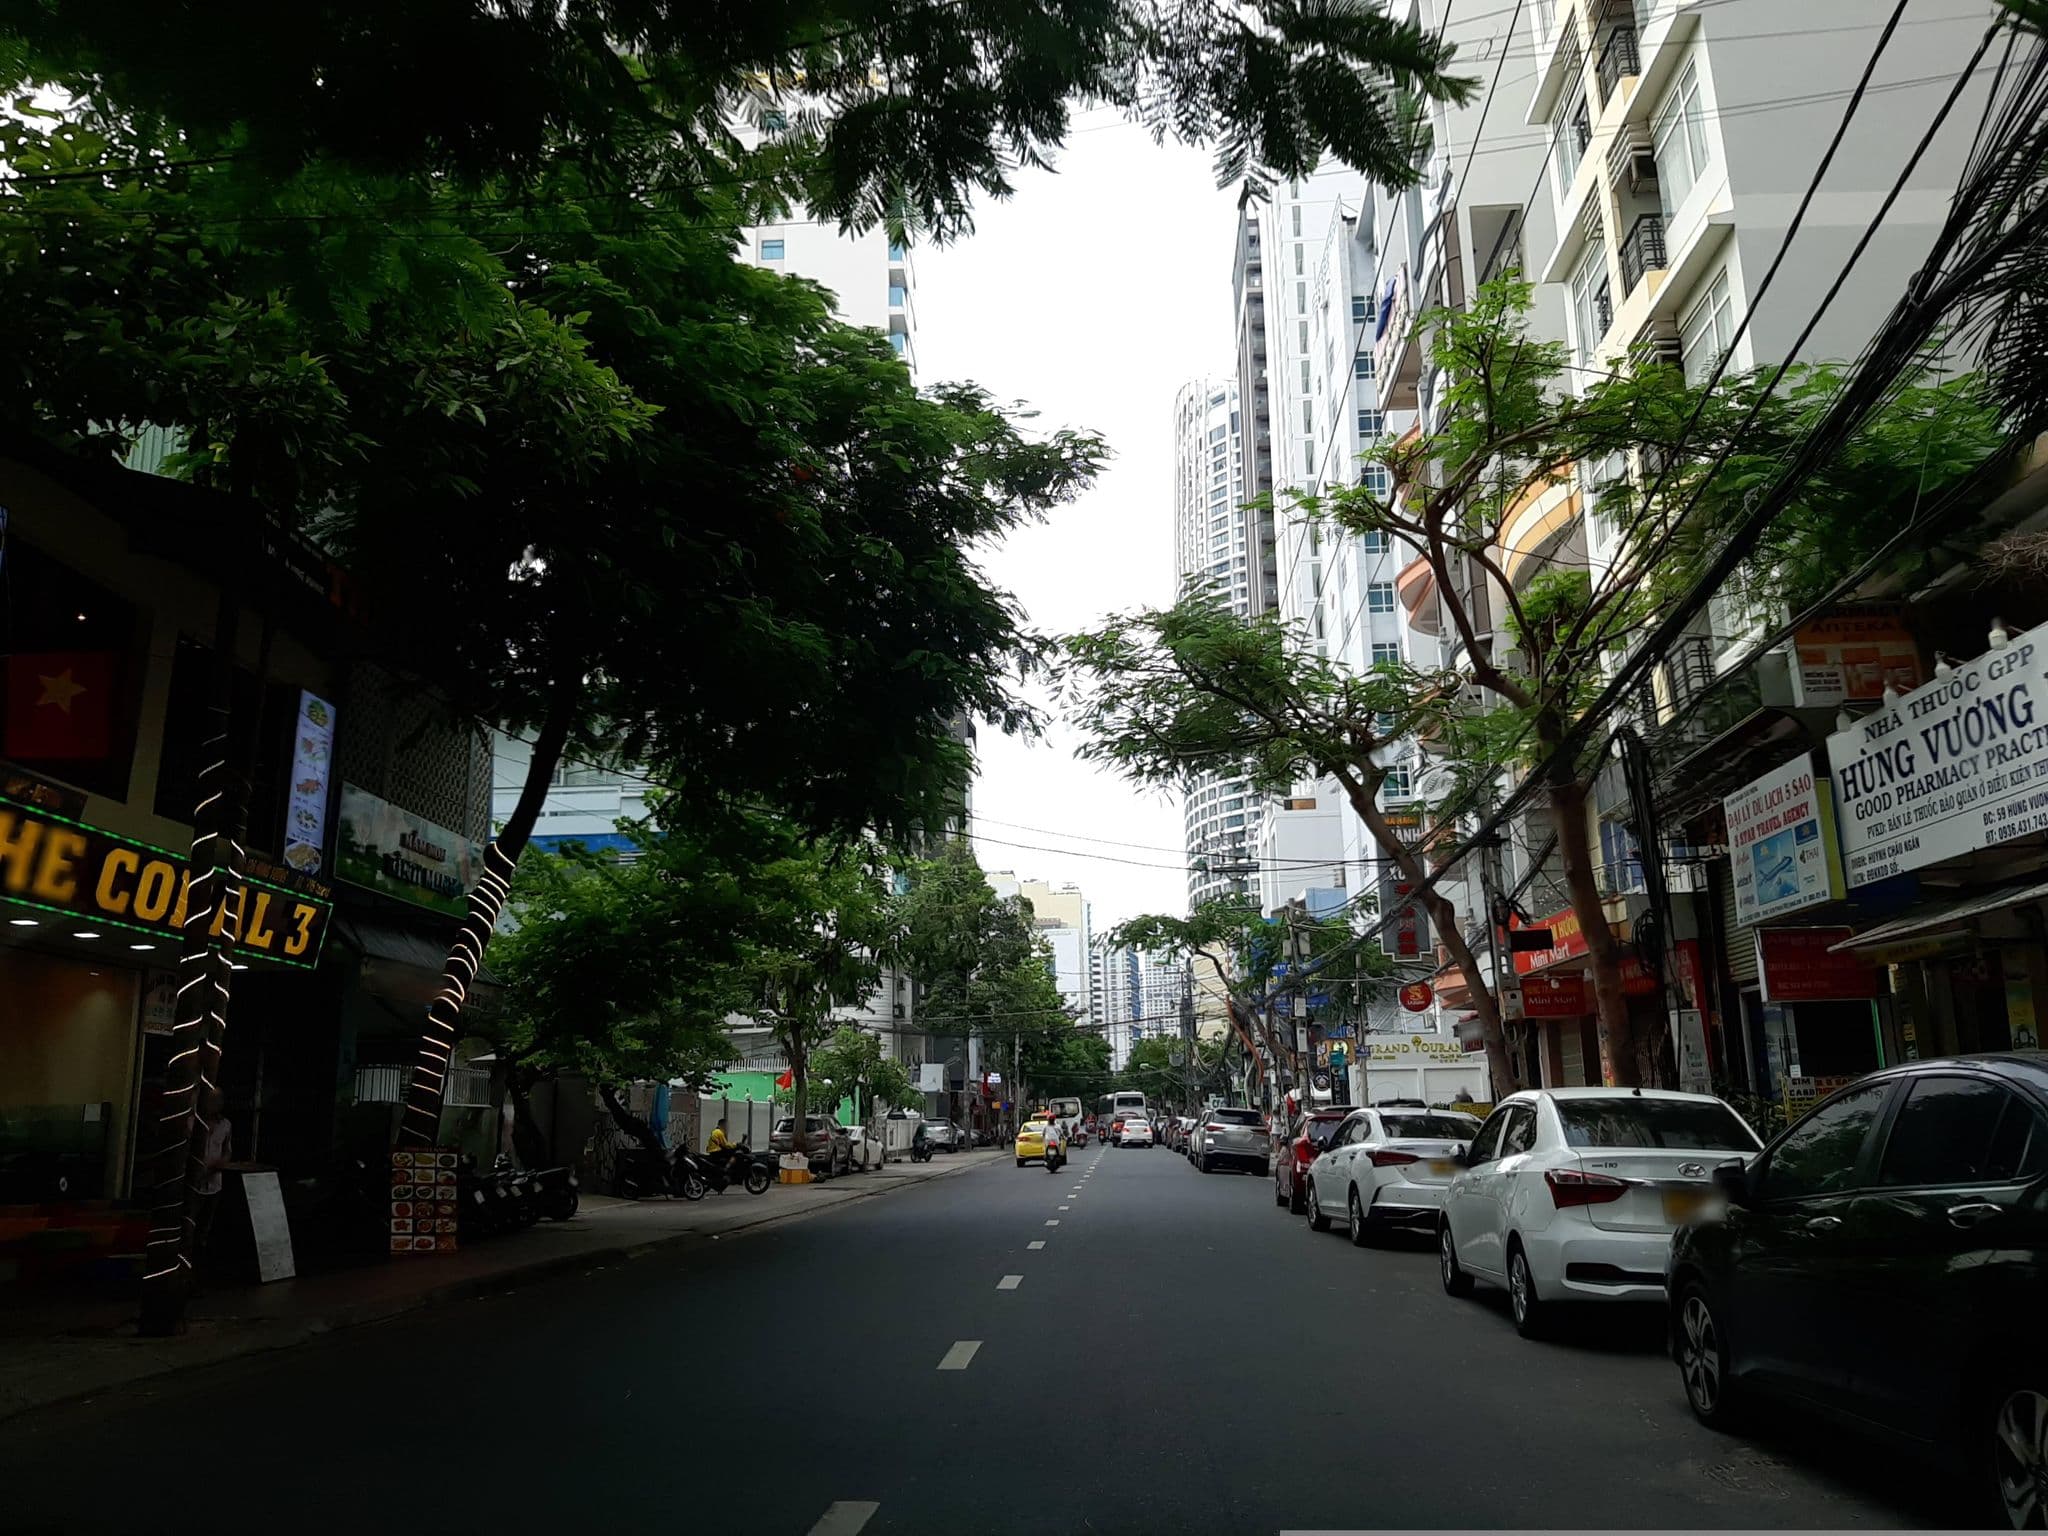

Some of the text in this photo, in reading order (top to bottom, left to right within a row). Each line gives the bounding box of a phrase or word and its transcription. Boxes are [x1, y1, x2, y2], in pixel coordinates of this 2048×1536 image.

[1863, 709, 1904, 743] NHÀ
[1908, 667, 1981, 721] THUỐC
[1987, 644, 2034, 681] GPP
[1839, 683, 2034, 803] HÙNG VƯƠNG
[1792, 773, 1812, 798] SAO
[1856, 791, 1892, 821] GOOD
[1897, 755, 1981, 806] PHARMACY
[1782, 801, 1811, 826] AGENCY
[1997, 806, 2006, 821] 59
[283, 903, 317, 956] 3
[1530, 942, 1570, 969] Mini Mart
[1528, 996, 1551, 1006] Mini
